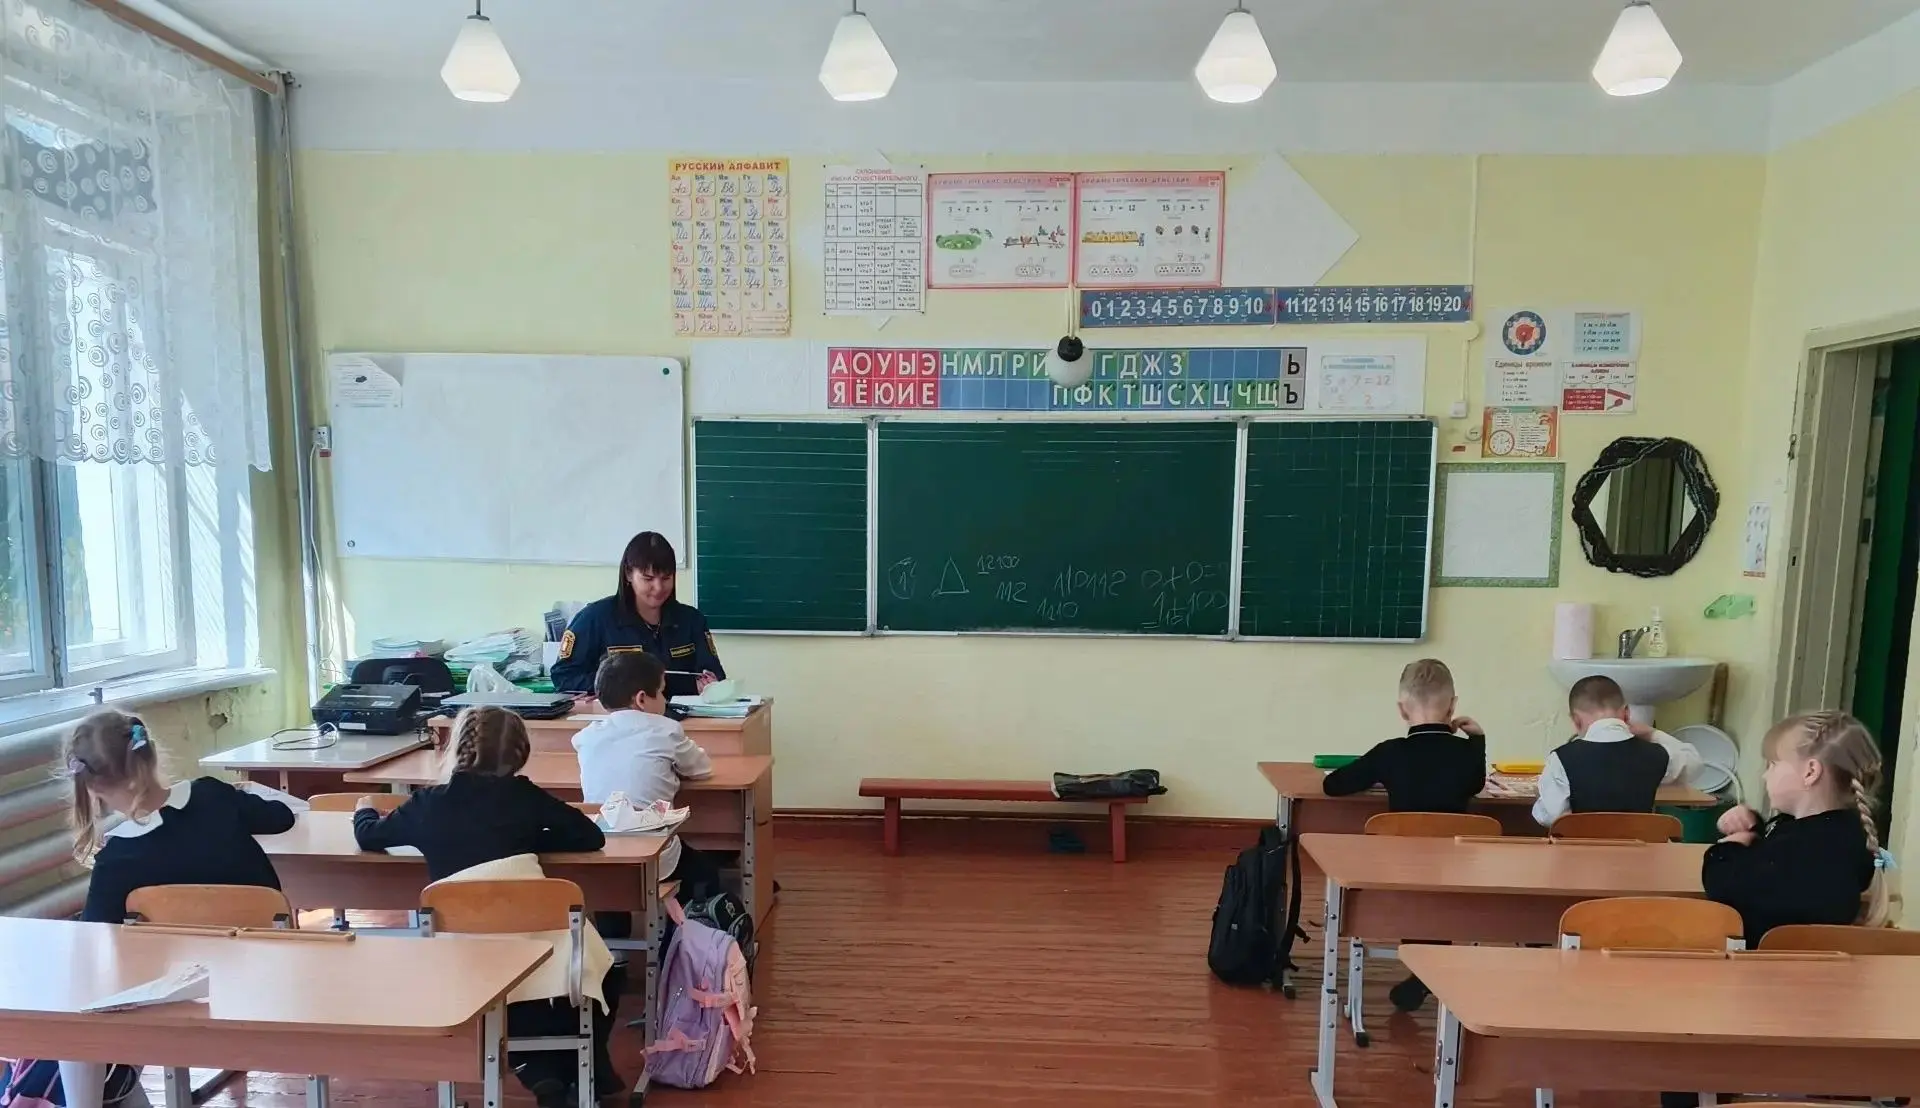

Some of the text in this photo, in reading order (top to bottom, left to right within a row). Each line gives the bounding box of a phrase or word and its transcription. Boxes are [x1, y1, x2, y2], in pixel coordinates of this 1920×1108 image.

[729, 162, 781, 170] АЛФАВИТ
[1092, 297, 1263, 317] 0 1 2 3 4 5 6 7 8 9 10
[1285, 295, 1461, 313] 11 12 13 14 15 16 17 18 19 20
[1376, 375, 1391, 384] 12
